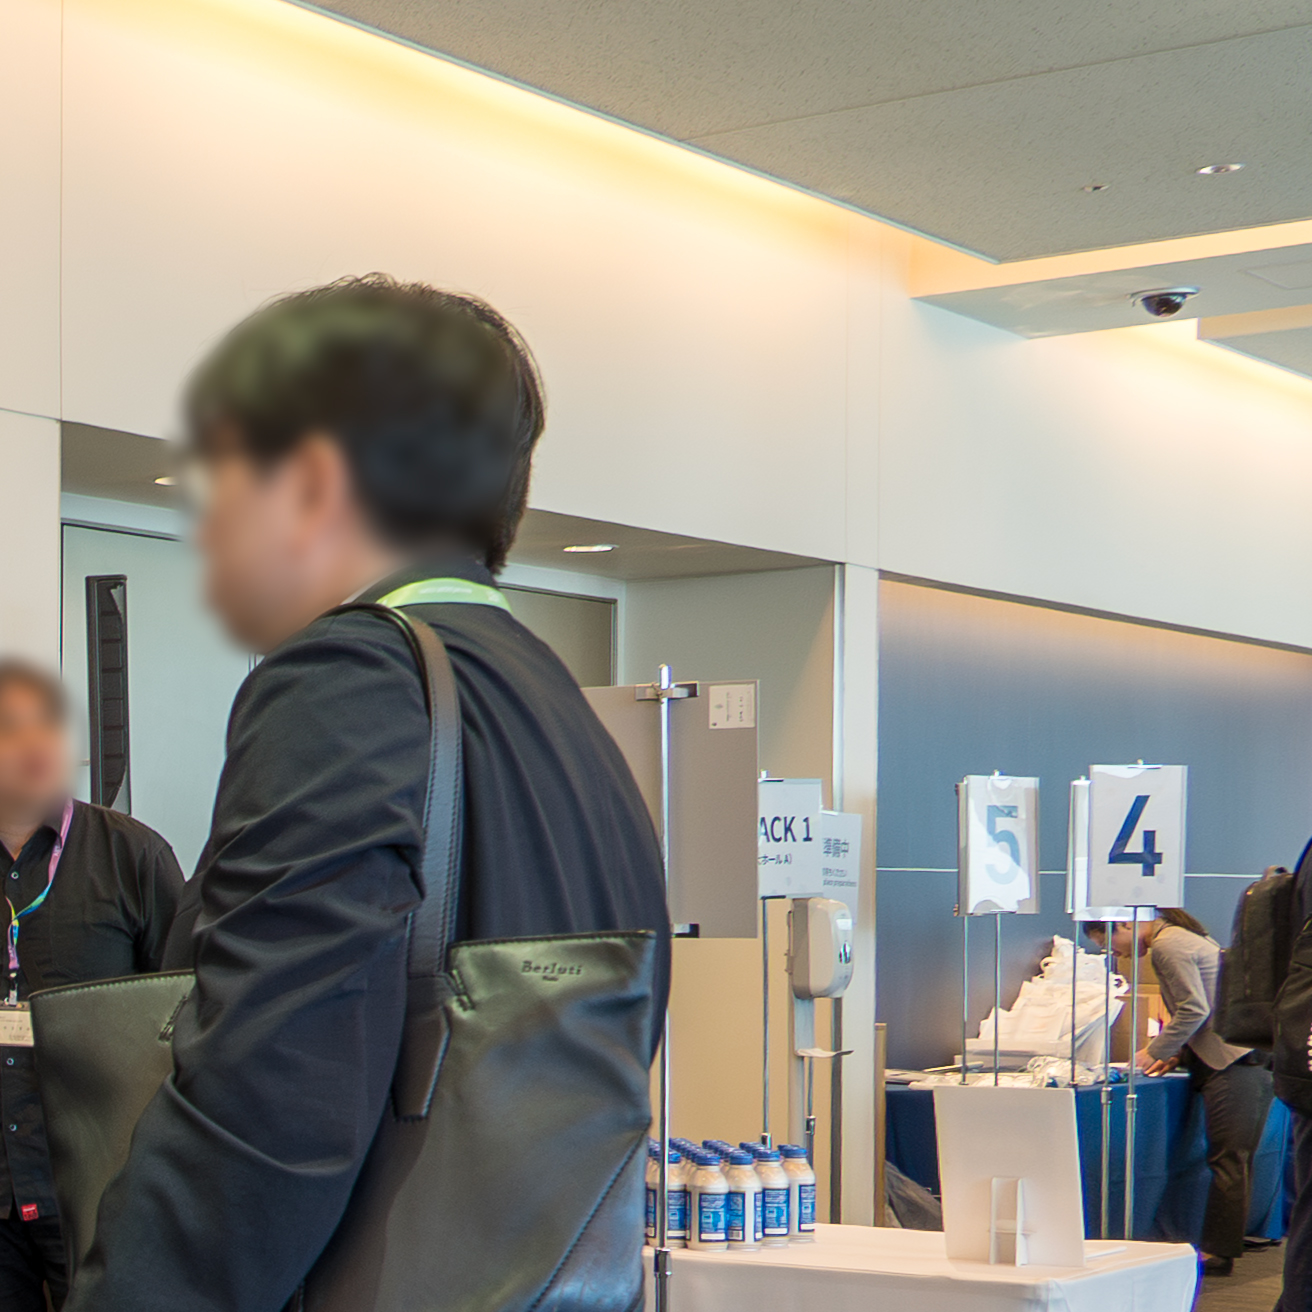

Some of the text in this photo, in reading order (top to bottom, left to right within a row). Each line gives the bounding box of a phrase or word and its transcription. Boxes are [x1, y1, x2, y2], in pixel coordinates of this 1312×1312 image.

[803, 817, 813, 842] 1
[985, 805, 1021, 885] 5
[1107, 795, 1163, 877] 4
[521, 960, 582, 975] Berluti
